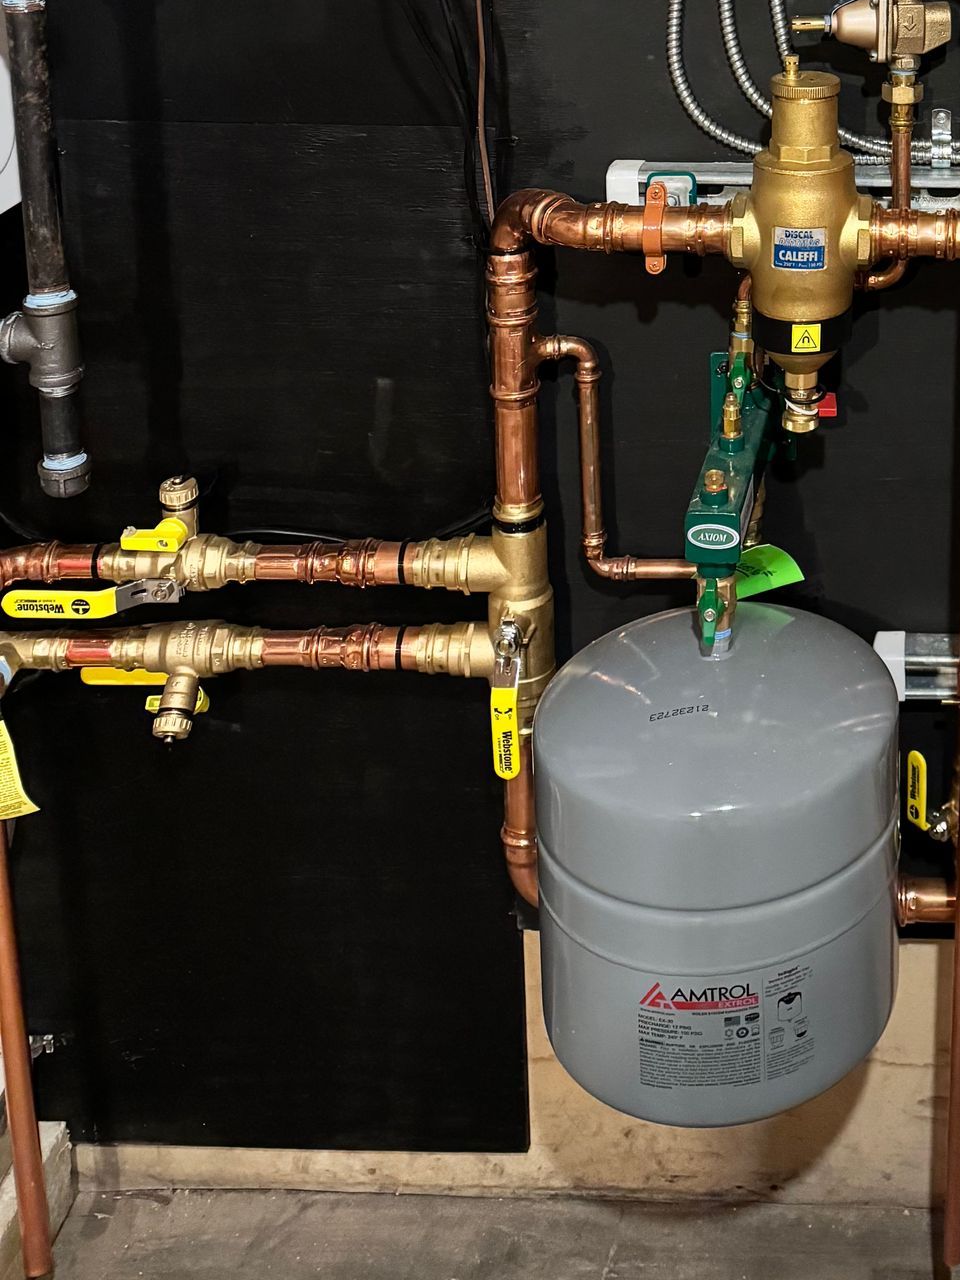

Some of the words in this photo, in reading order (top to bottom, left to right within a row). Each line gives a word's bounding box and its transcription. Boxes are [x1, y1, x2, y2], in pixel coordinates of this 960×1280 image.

[778, 250, 818, 261] CALEFFI
[697, 532, 727, 542] AXIOM
[15, 603, 65, 614] Webstone
[648, 704, 709, 722] 21232723
[502, 730, 513, 773] Webstone
[670, 983, 757, 1002] AMTROL
[718, 996, 759, 1009] EXTROL
